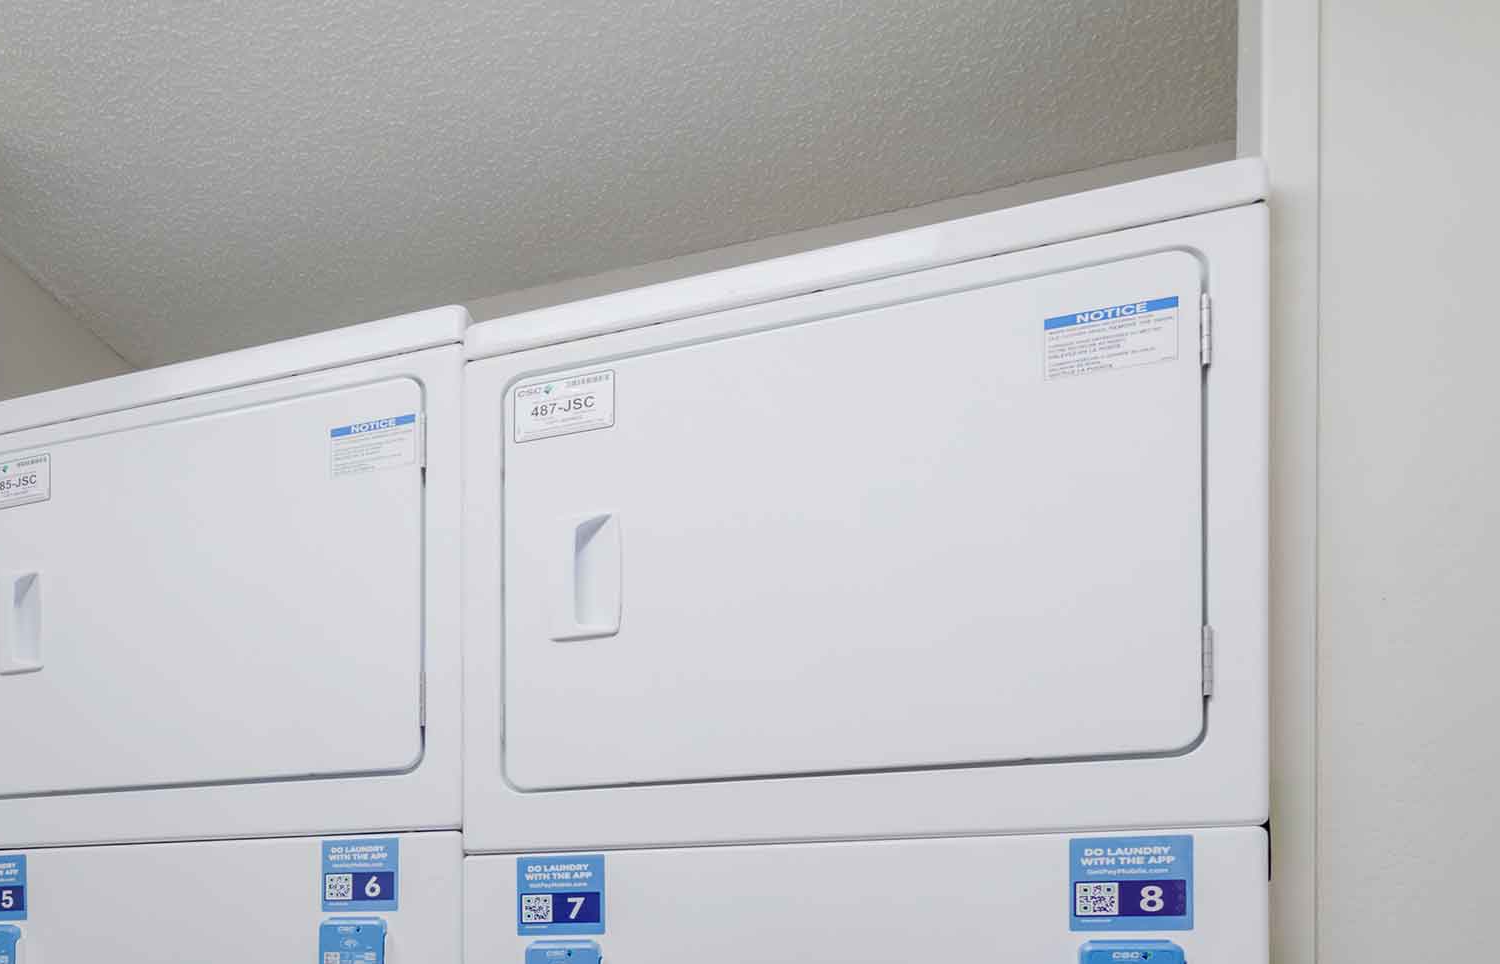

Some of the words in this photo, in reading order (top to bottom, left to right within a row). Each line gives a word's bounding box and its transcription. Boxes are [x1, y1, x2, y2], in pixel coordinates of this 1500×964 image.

[1076, 302, 1148, 323] NOTICE
[531, 395, 595, 417] 487-JSC
[351, 418, 397, 433] NOTICE
[1080, 857, 1116, 866] WITH
[1119, 857, 1145, 865] THE
[1147, 855, 1176, 865] APP
[1084, 847, 1104, 857] DO
[1107, 846, 1171, 856] LAUNDRY
[524, 872, 548, 881] WITH
[549, 872, 571, 880] THE
[572, 871, 593, 879] APP
[544, 863, 589, 872] LAUNDRY
[365, 875, 381, 897] 6
[1, 889, 14, 909] 5
[567, 896, 586, 919] 7
[1139, 885, 1165, 912] 8
